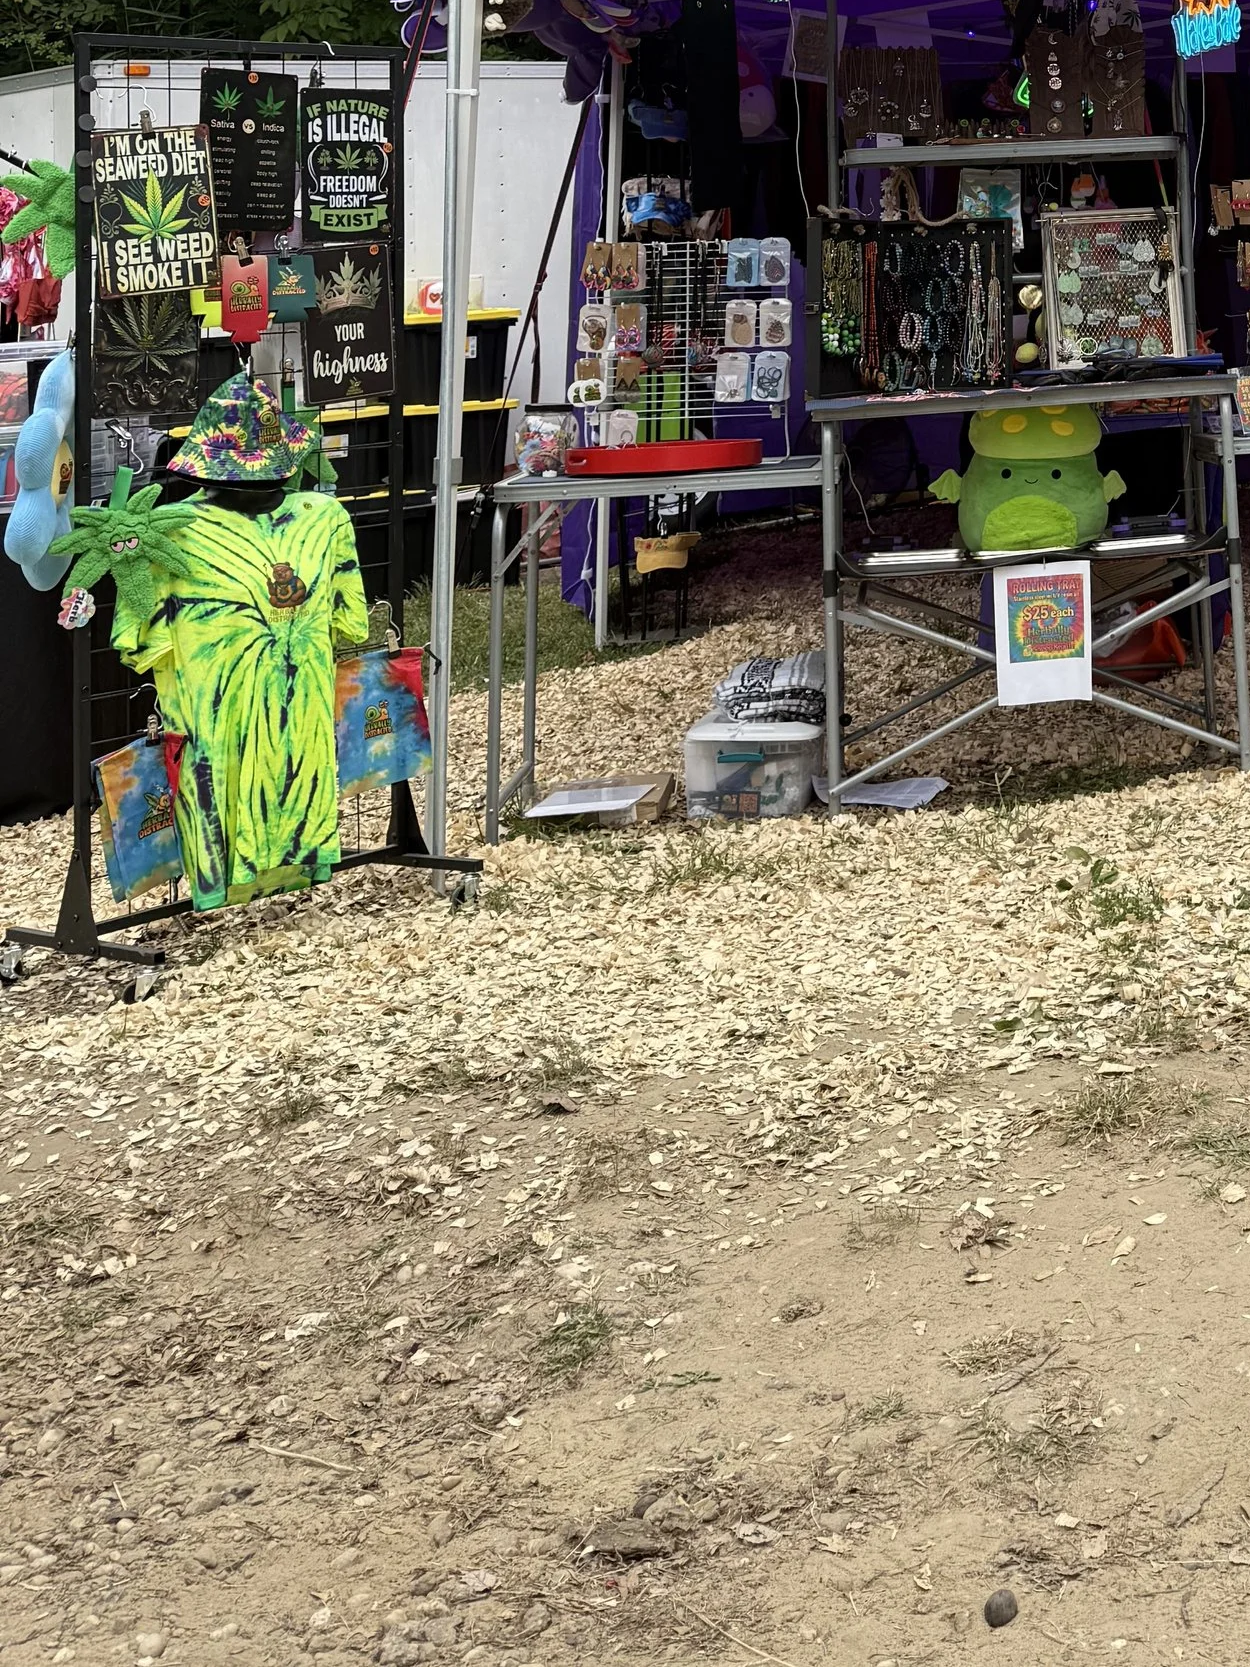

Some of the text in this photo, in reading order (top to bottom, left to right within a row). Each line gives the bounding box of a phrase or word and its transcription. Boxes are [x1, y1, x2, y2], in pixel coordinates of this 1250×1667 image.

[306, 99, 390, 120] IF NATURE
[211, 119, 235, 129] Sativa
[262, 122, 285, 133] Indica
[307, 112, 388, 144] IS ILLEGAL
[103, 130, 196, 157] I'M ON THE
[95, 151, 206, 183] SEAWEED DIET
[319, 174, 377, 193] FREEDOM
[329, 194, 368, 209] DOESN'T
[323, 212, 374, 228] EXIST
[102, 232, 214, 268] I SEE WEED
[104, 268, 112, 294] I
[116, 260, 183, 294] SMOKE
[186, 257, 213, 285] IT
[334, 322, 365, 343] YOUR
[312, 345, 389, 385] highness
[1013, 581, 1053, 594] ROLLING
[1023, 605, 1074, 621] $25 each
